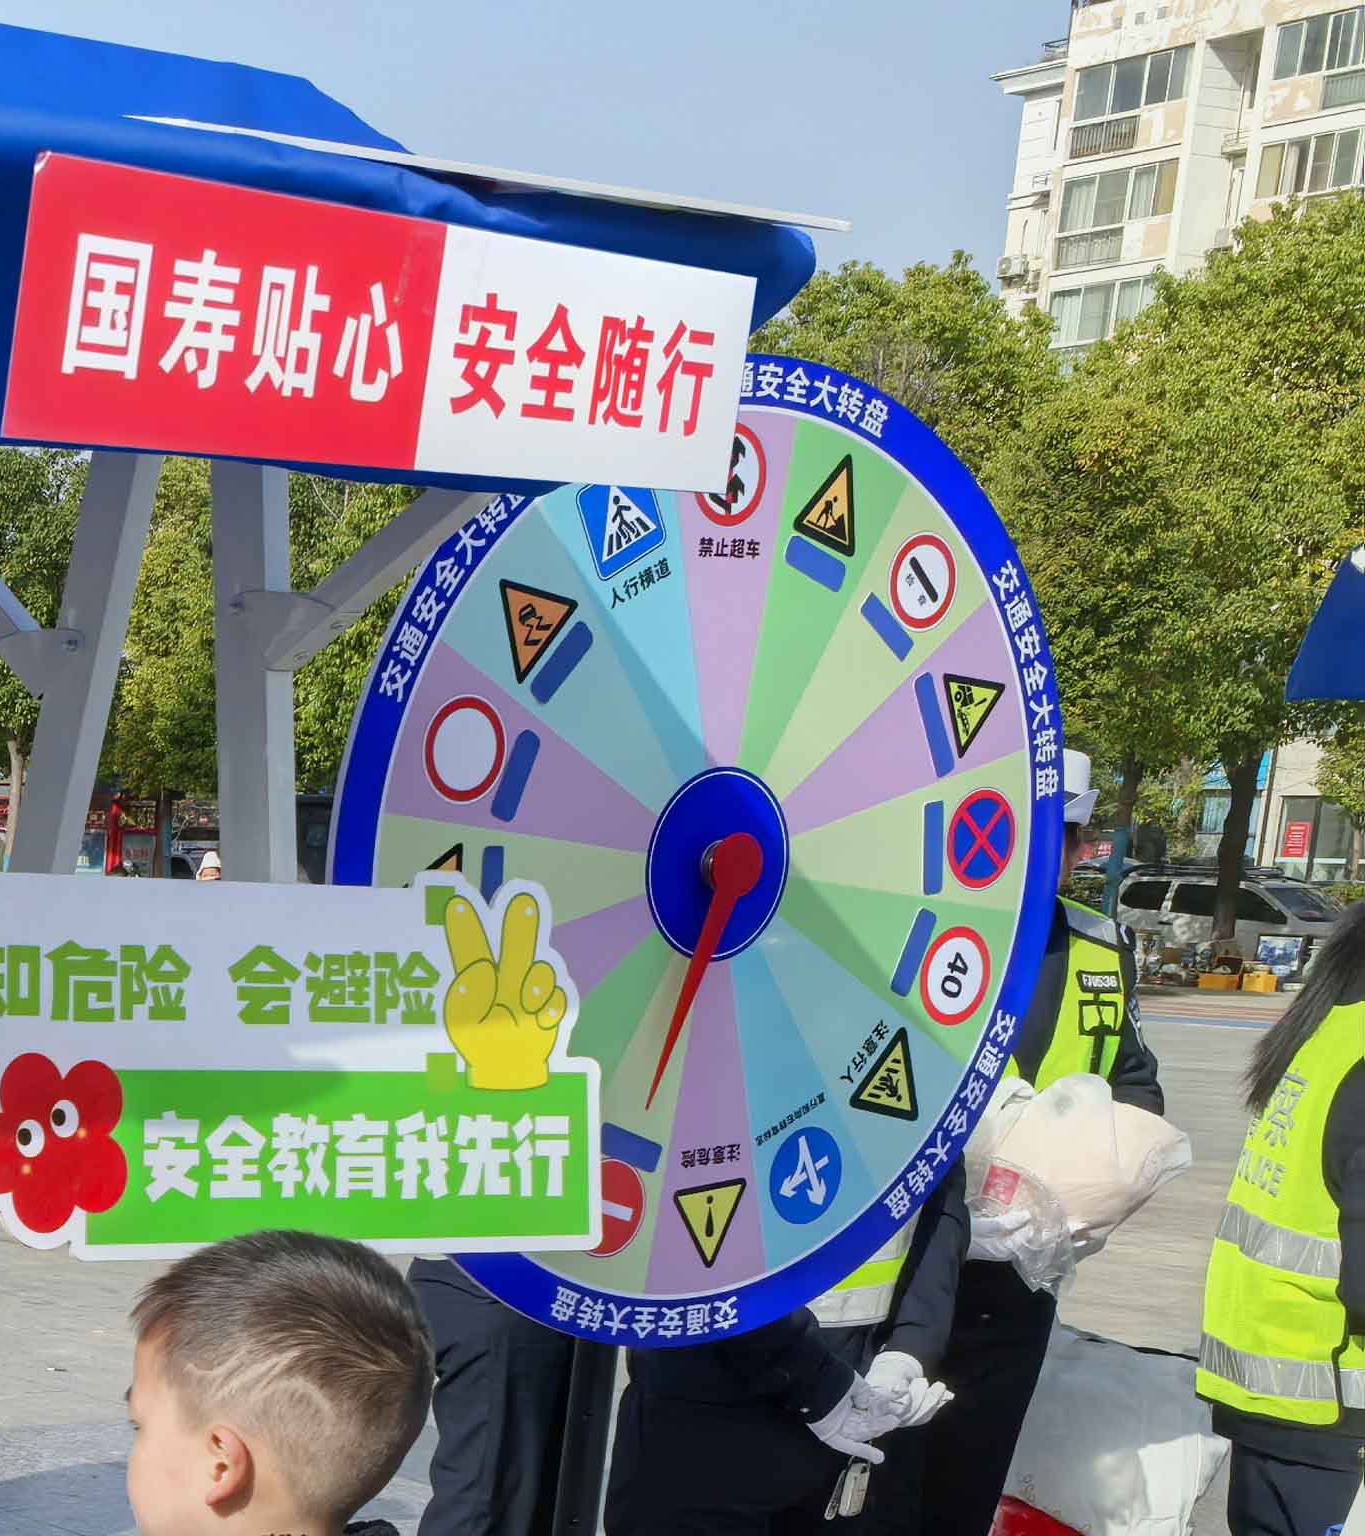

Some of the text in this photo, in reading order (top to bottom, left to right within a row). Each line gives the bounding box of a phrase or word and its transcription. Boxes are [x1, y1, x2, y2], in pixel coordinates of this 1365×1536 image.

[60, 233, 716, 437] 国寿贴心 安全随行
[698, 538, 761, 560] 禁止超车
[608, 557, 671, 609] 人行横道
[991, 559, 1060, 800] 交通安全大转盘
[227, 944, 441, 1025] 会避险
[941, 952, 969, 999] 40
[840, 1019, 890, 1085] 注意行人
[882, 1009, 1017, 1221] 交通安全大转盘
[142, 1110, 570, 1202] 安全教育我先行
[680, 1143, 741, 1169] 注意危险
[550, 1285, 740, 1339] 交通安全大转盘
